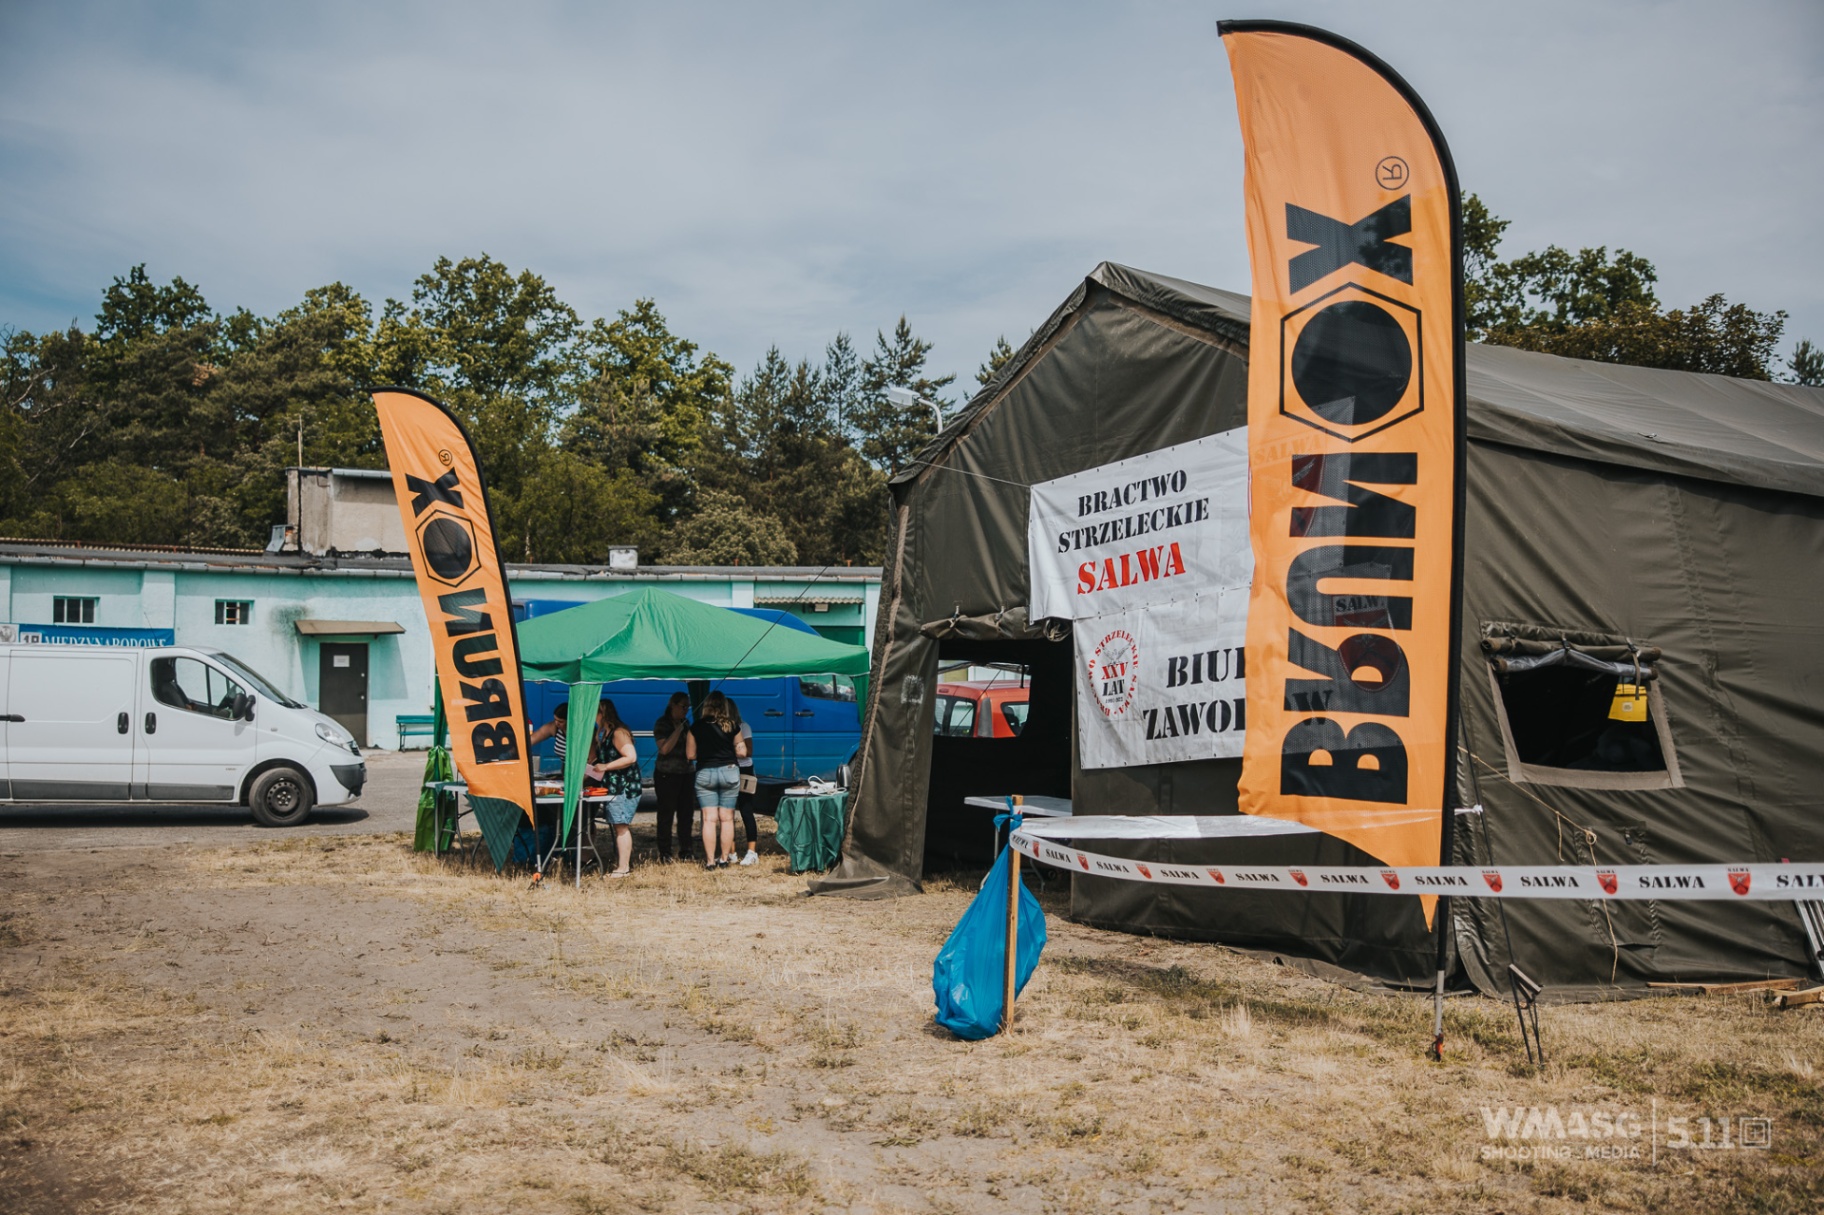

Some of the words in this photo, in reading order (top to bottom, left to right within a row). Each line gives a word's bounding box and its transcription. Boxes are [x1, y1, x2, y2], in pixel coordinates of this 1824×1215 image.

[1077, 469, 1187, 517] BRACTWO
[1058, 498, 1209, 553] STRZELECKIE
[1077, 541, 1186, 595] SALWA
[1101, 662, 1128, 680] XXV
[1102, 679, 1125, 696] LAT
[1046, 848, 1071, 863] SALWA
[1096, 861, 1130, 873] SALWA
[1160, 869, 1200, 880] SALWA
[1235, 873, 1280, 883] SALWA
[1321, 874, 1369, 885] SALWA
[1415, 876, 1468, 886] SALWA
[1520, 876, 1579, 887] SALWA
[1639, 876, 1705, 888] SALWA
